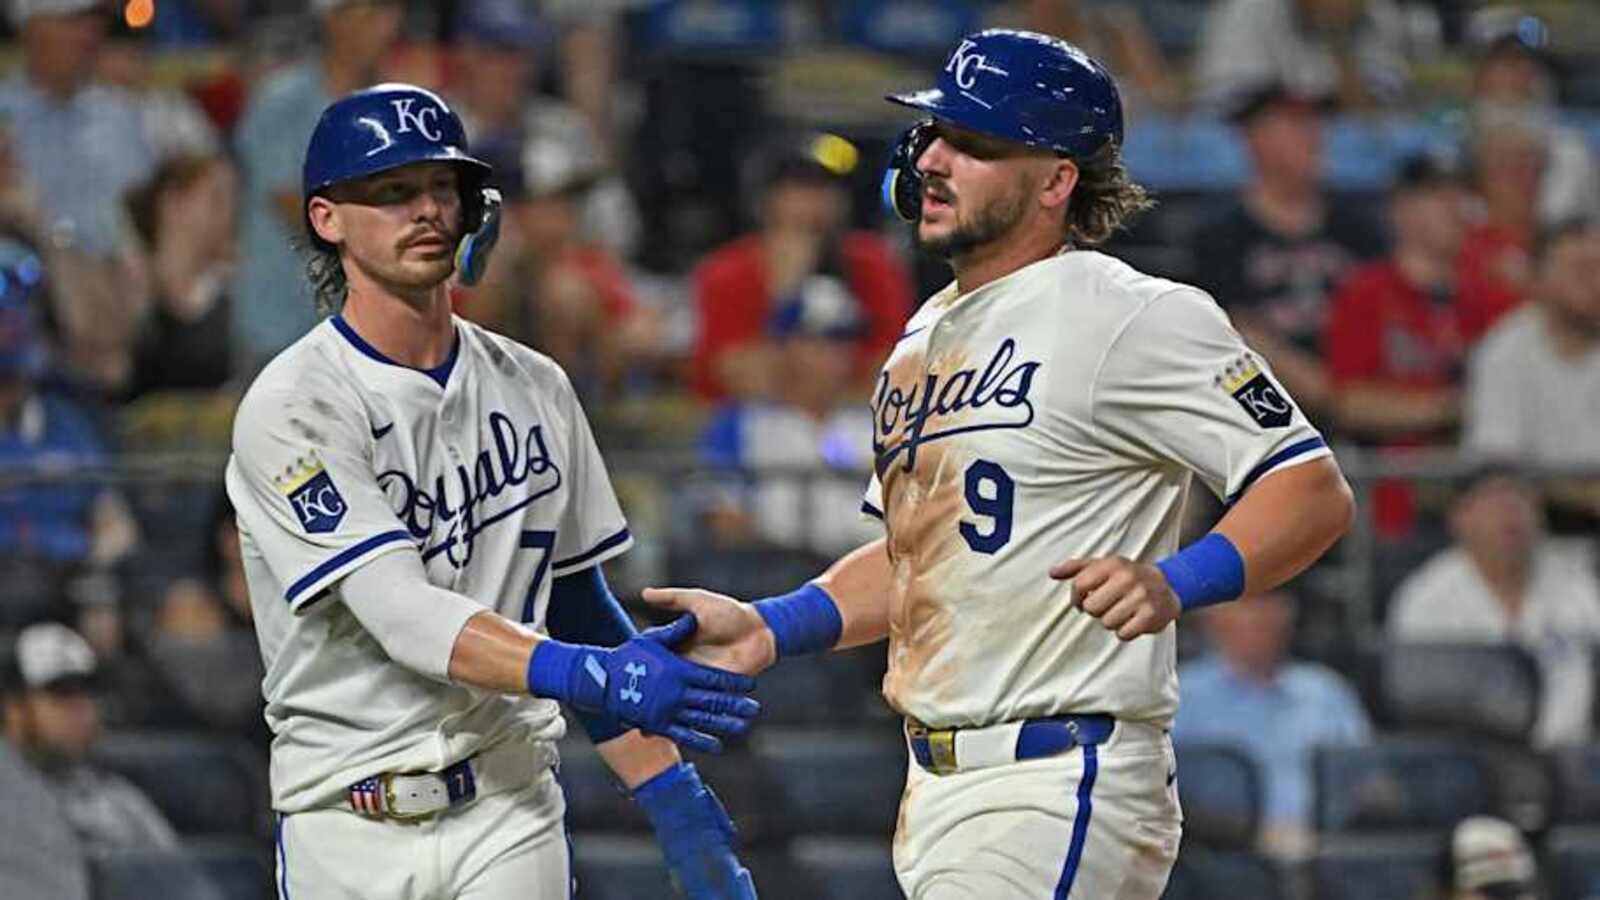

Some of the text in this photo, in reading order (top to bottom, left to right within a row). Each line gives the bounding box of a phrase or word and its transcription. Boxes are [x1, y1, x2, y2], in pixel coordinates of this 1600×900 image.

[944, 40, 986, 90] KC
[390, 98, 442, 141] KC
[1238, 387, 1288, 419] KC
[292, 485, 342, 523] KC
[959, 458, 1014, 555] 9
[520, 530, 556, 623] 7
